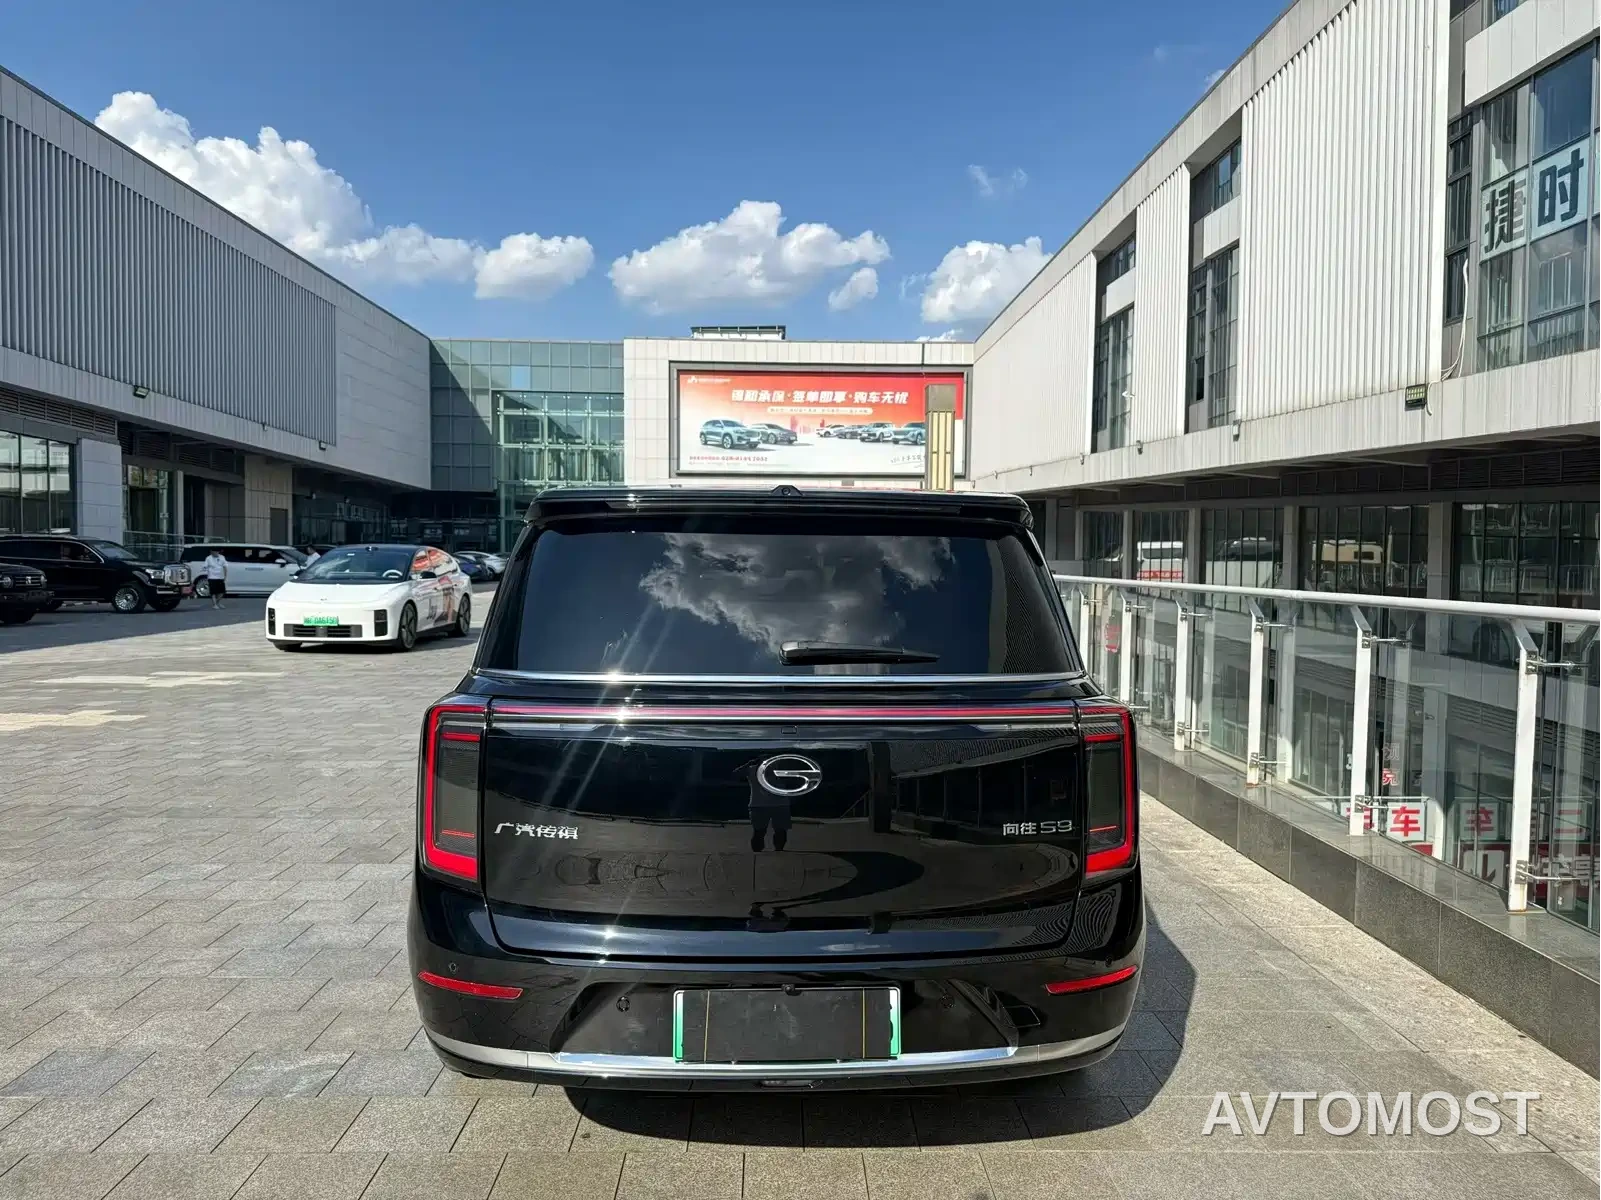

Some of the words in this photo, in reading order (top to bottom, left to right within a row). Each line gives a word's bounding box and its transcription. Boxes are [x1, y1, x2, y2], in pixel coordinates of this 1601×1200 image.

[494, 822, 579, 839] 广汽传祺
[1003, 822, 1037, 836] 向往
[1040, 820, 1072, 834] S9
